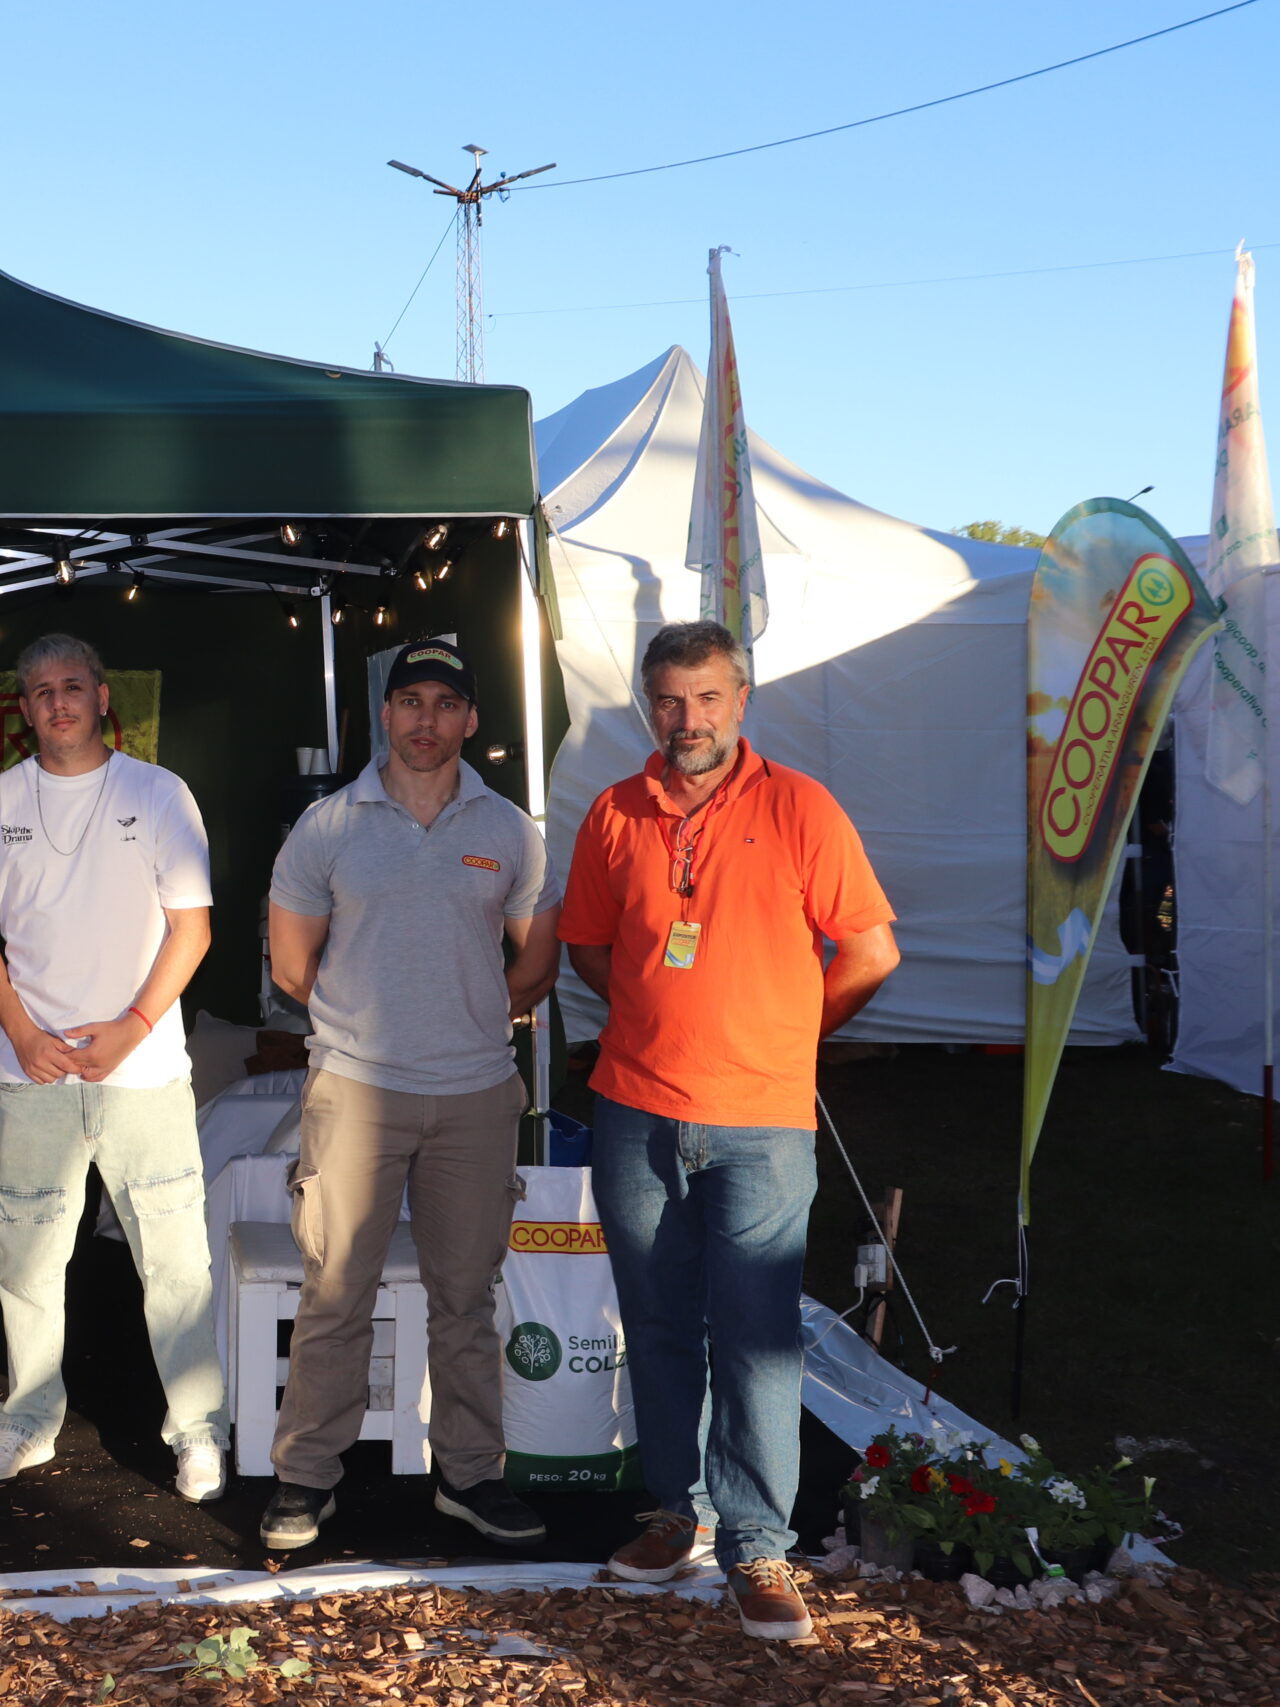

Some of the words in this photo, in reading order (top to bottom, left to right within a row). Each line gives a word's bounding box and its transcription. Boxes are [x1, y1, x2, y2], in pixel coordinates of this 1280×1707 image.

[410, 649, 451, 660] COOPAR
[1214, 652, 1263, 717] cooperativa
[1048, 601, 1161, 837] COOPAR
[1084, 740, 1115, 826] COOPERATIVA
[1111, 663, 1143, 739] ARANGUREN
[1142, 636, 1160, 662] LTDA
[2, 834, 33, 845] Drama
[568, 1351, 627, 1374] COLZ
[529, 1473, 563, 1482] PESO:
[568, 1470, 591, 1481] 20
[593, 1472, 607, 1482] kg
